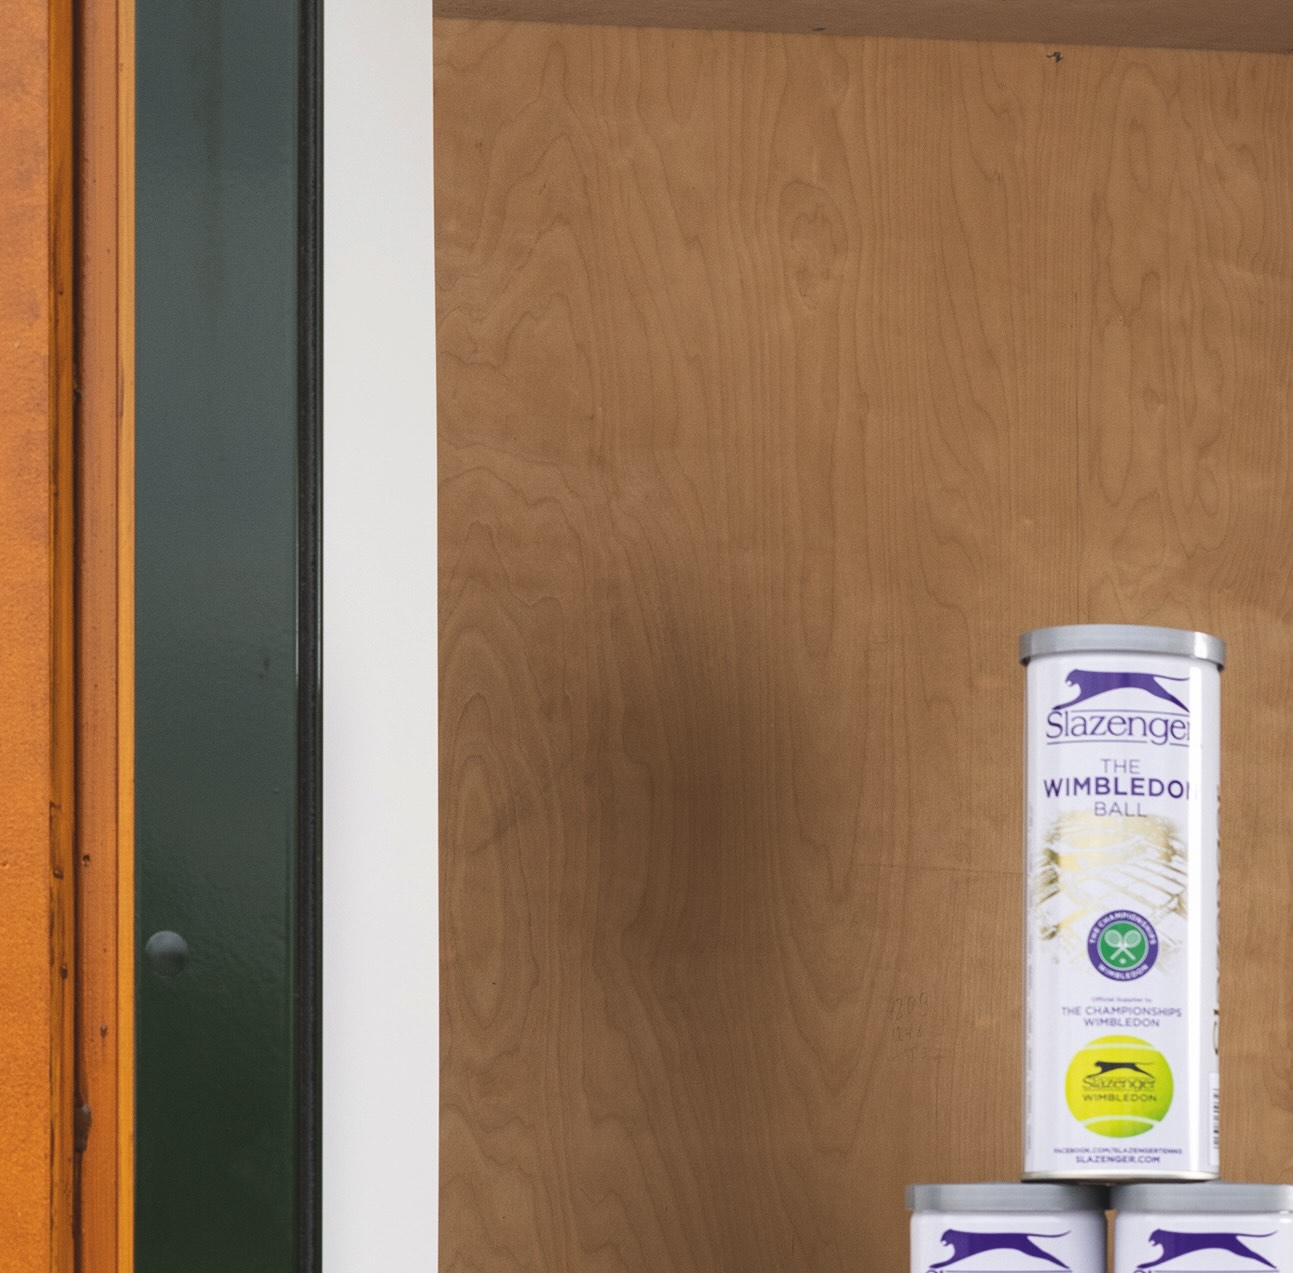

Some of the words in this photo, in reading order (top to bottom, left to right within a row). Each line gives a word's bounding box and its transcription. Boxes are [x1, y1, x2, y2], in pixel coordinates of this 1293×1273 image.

[1100, 759, 1141, 774] THE
[1094, 802, 1147, 817] BALL
[1062, 1007, 1081, 1016] THE
[1086, 1006, 1181, 1017] CHAMPIONSHIPS
[1084, 1018, 1160, 1028] WIMBLEDON
